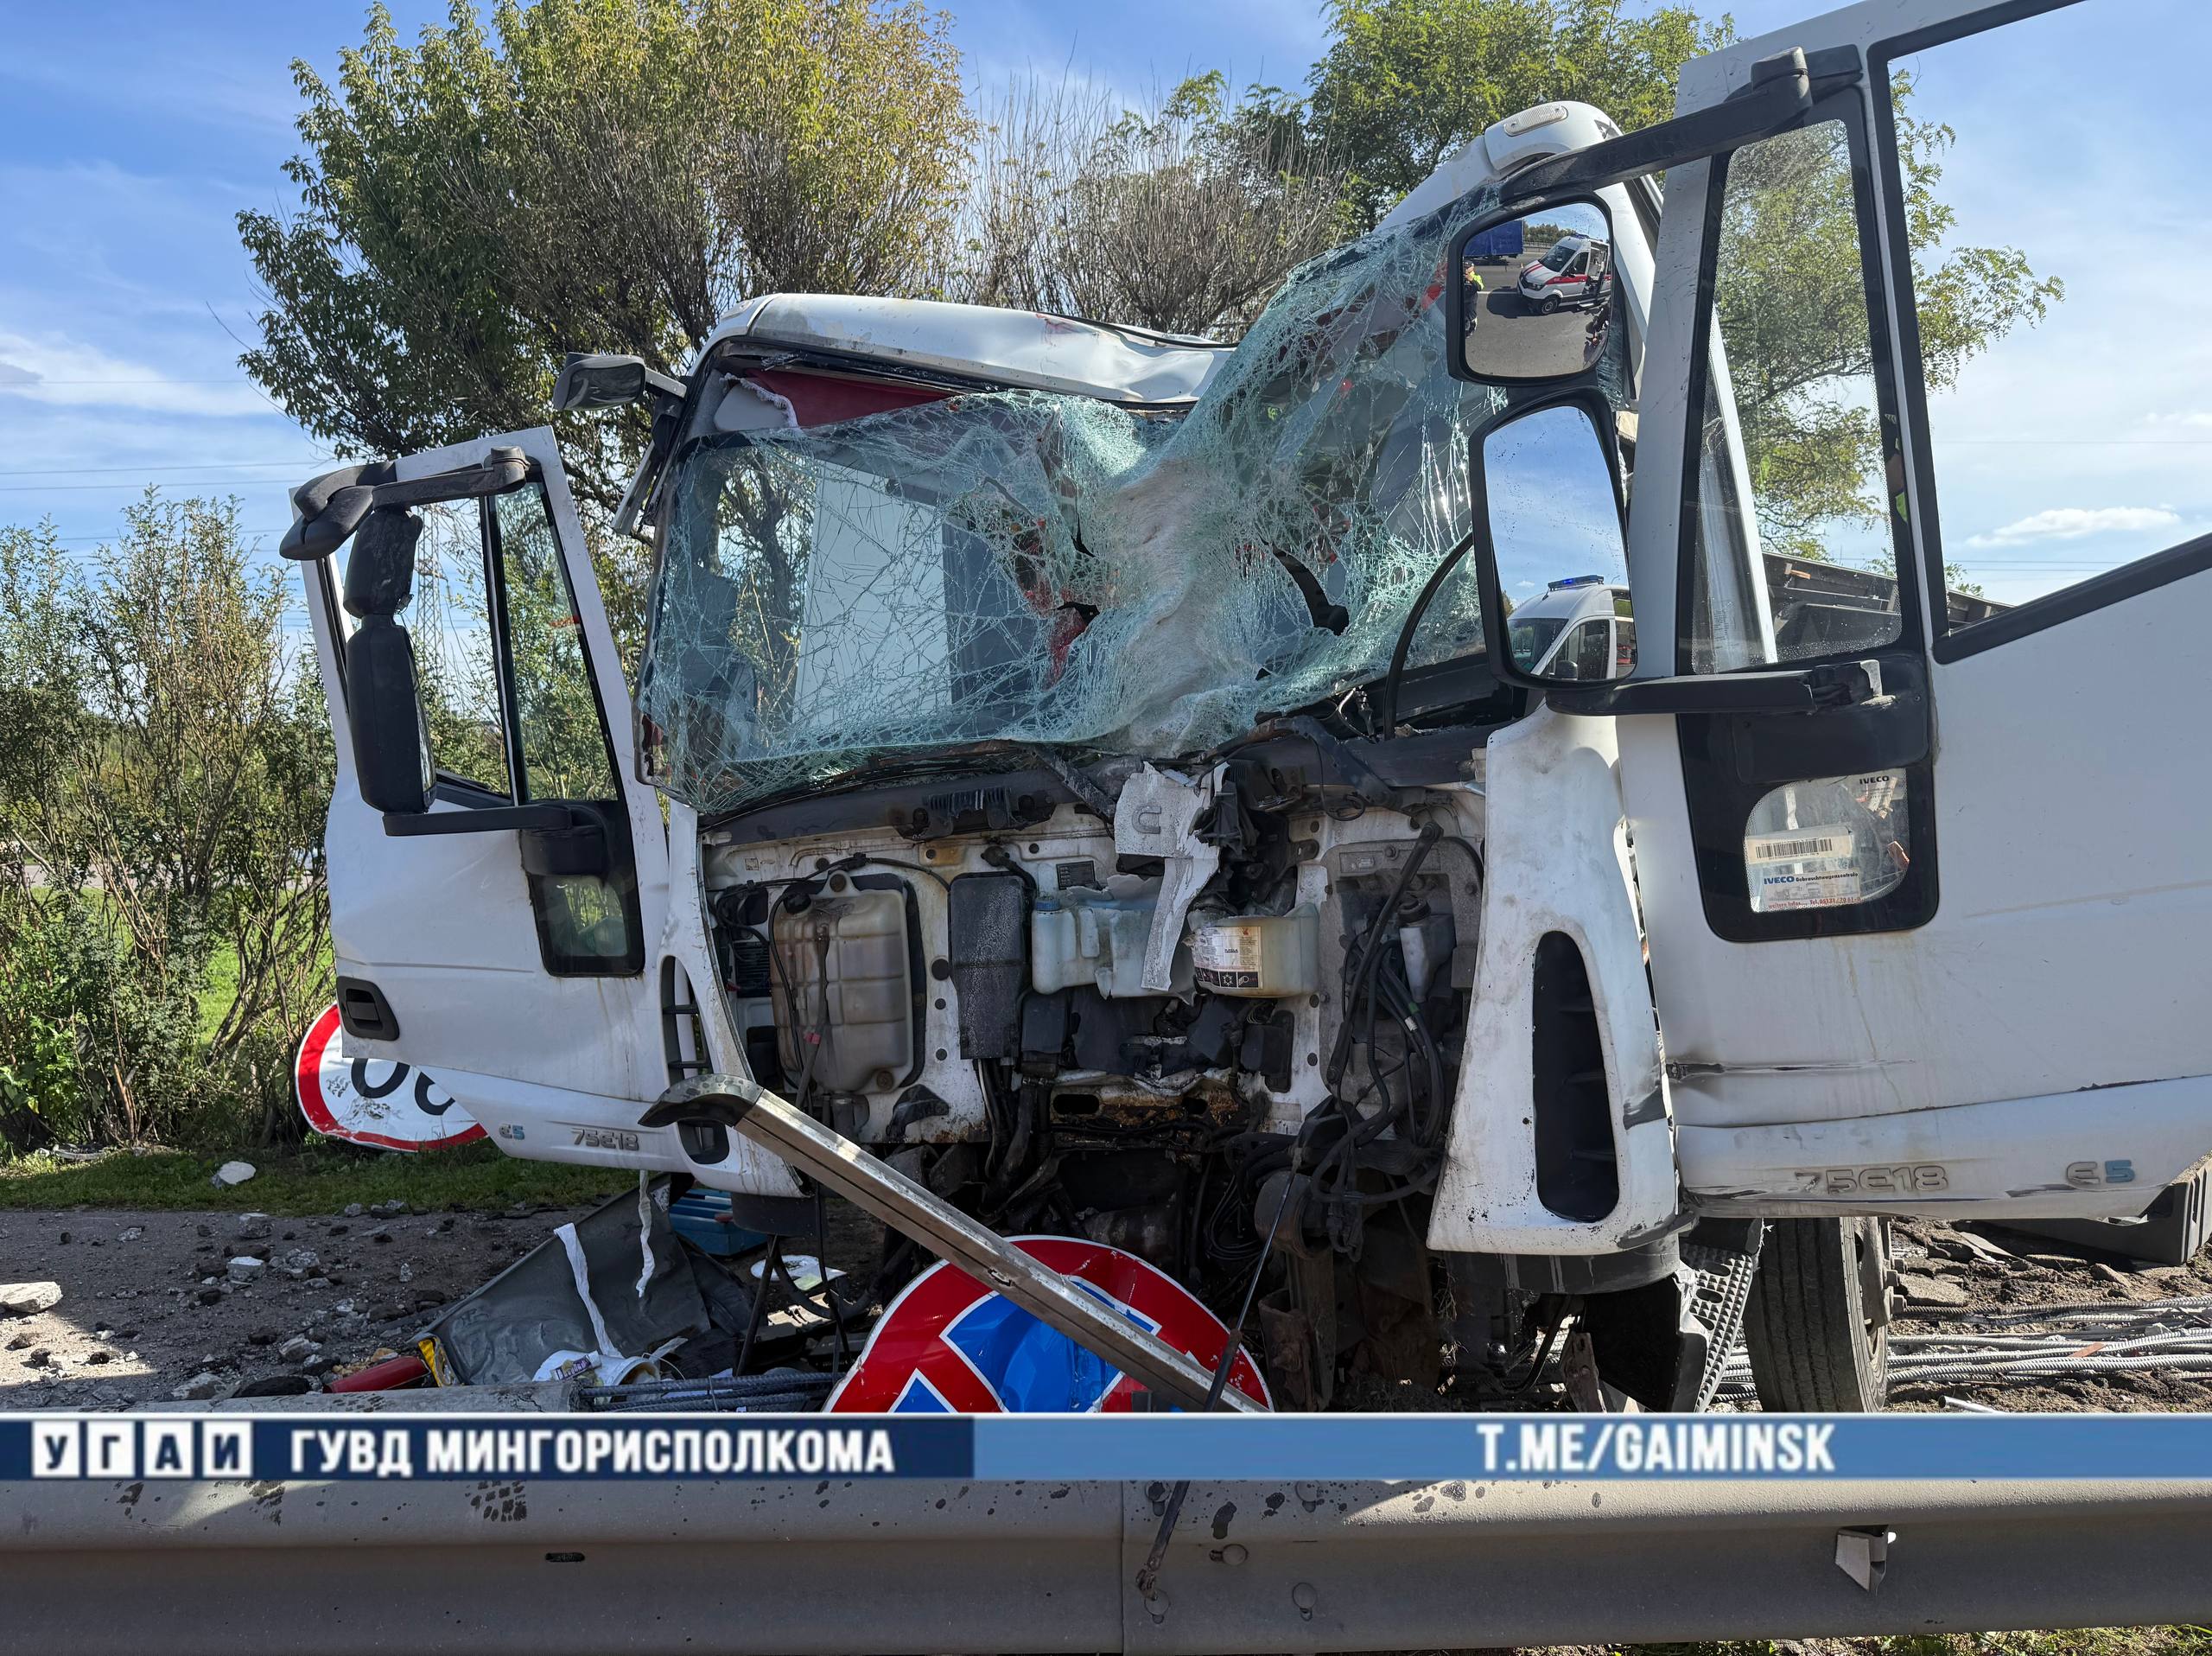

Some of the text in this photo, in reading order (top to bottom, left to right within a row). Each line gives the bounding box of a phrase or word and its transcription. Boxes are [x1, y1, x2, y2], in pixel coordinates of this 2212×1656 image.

[1859, 775, 1890, 785] IVECO
[1764, 876, 1795, 885] IVECO
[499, 1124, 640, 1151] E5 75E18
[1795, 1159, 2136, 1194] 75E18 E5
